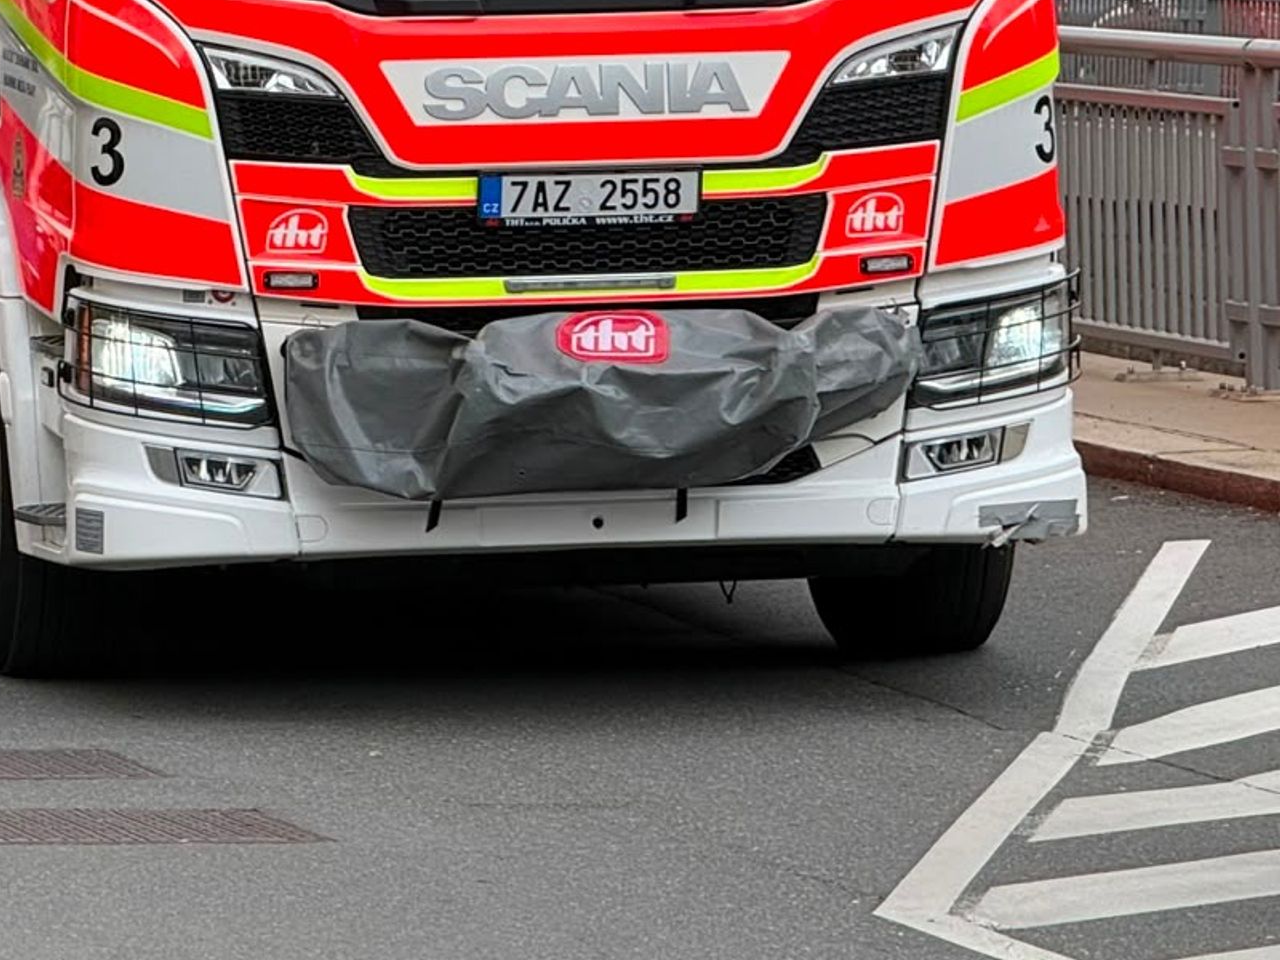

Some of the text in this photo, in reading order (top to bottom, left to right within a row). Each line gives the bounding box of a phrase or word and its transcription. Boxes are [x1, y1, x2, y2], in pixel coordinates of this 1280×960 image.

[423, 60, 750, 121] SCANIA
[91, 117, 125, 187] 3
[1034, 95, 1055, 164] 3
[482, 177, 682, 214] CZ 7AZ 2558
[595, 213, 674, 225] www.tht.cz
[576, 319, 649, 352] tht
